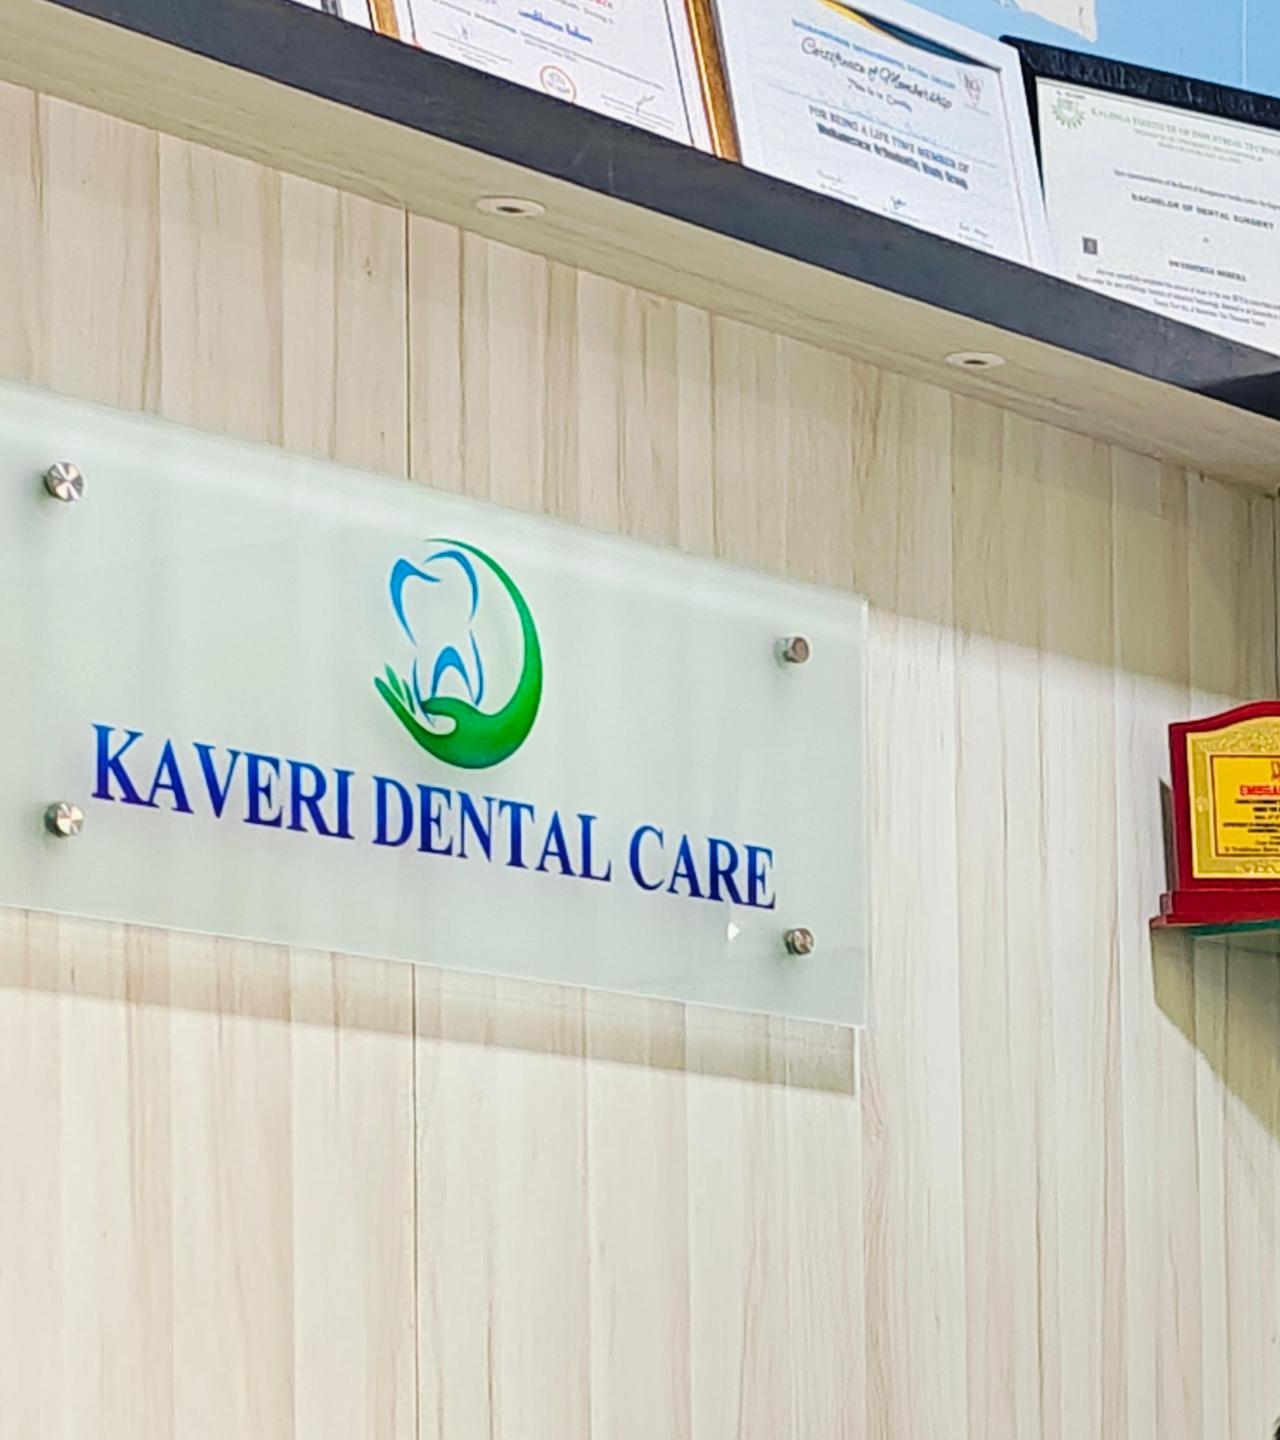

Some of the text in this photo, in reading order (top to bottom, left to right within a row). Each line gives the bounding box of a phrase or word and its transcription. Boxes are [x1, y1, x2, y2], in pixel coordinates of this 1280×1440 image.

[91, 723, 776, 911] KAVERI DENTAL CARE
